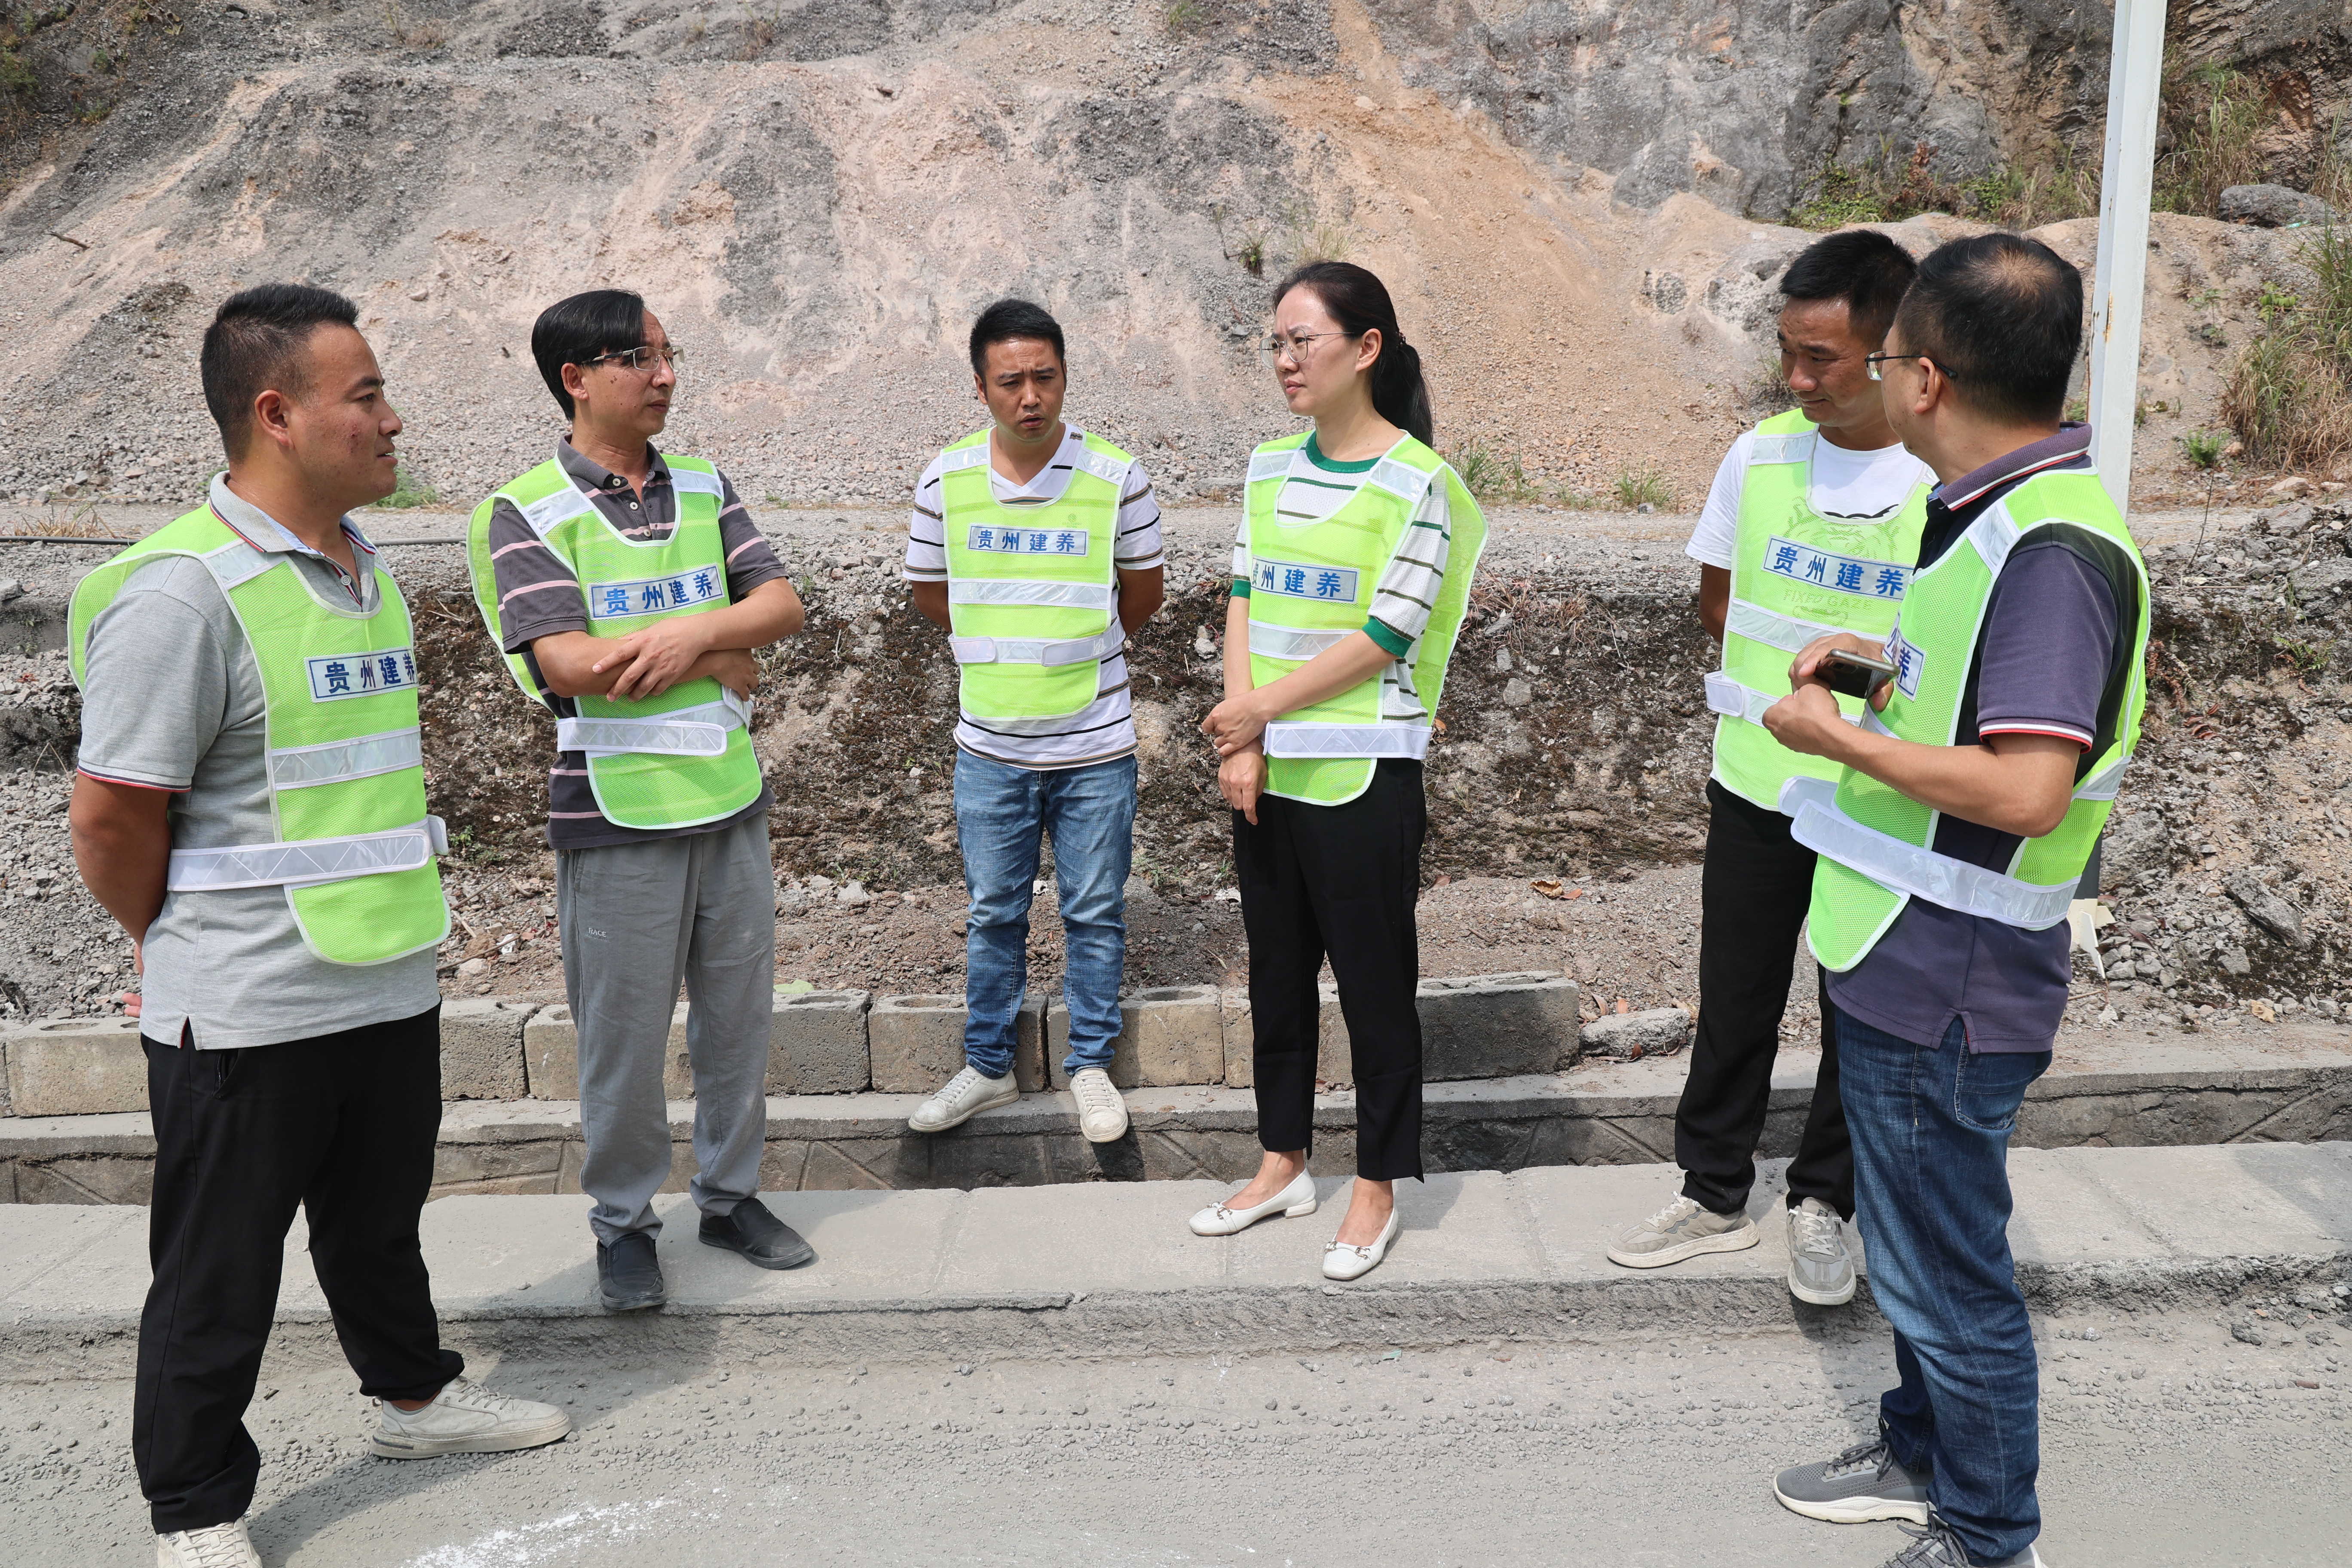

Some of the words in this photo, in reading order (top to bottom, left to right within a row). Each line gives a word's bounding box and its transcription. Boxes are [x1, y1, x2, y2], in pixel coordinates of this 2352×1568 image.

[978, 530, 1075, 552] 贵州建养
[1252, 562, 1341, 597] 贵州建养
[1773, 546, 1903, 596] 贵州建养
[604, 572, 713, 614] 贵州建养
[325, 652, 415, 694] 贵州建养
[588, 928, 606, 937] RACE
